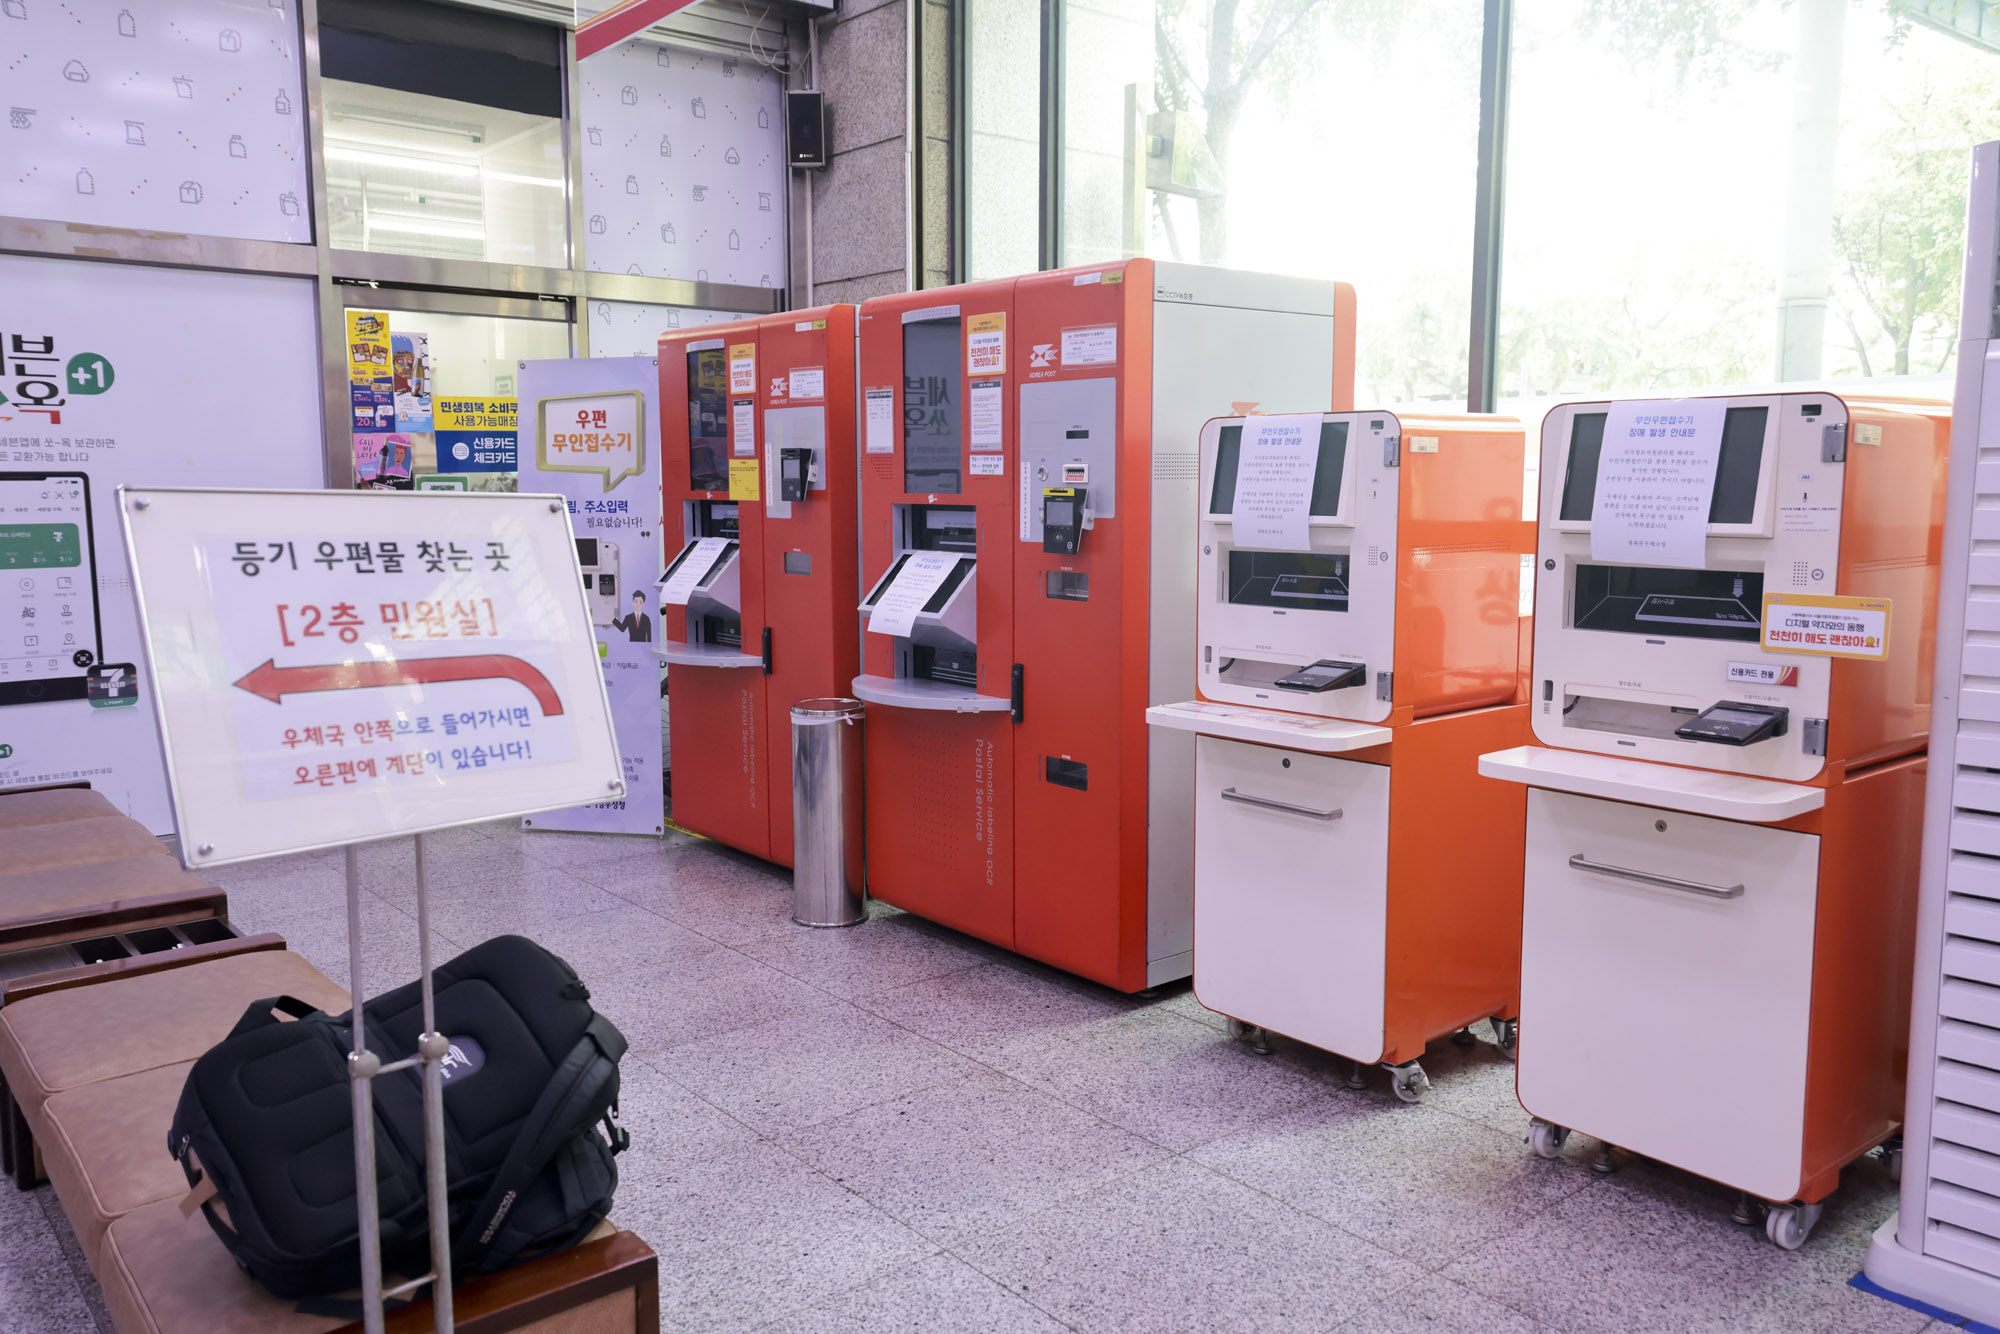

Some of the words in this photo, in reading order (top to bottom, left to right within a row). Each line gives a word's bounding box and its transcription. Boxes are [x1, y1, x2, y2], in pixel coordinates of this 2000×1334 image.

[0, 331, 60, 378] 븐
[71, 361, 105, 388] +1
[1029, 371, 1044, 379] KOREA
[440, 402, 485, 413] 민생회복
[575, 410, 607, 429] 우편
[473, 437, 516, 449] 신용카드
[552, 433, 632, 453] 무인접수기
[473, 452, 516, 464] 체크카드
[584, 499, 628, 514] 주소입력
[586, 517, 643, 529] 필요없습니다!
[232, 541, 298, 577] 등기
[313, 542, 404, 574] 우편물
[417, 540, 472, 572] 찾는
[484, 541, 511, 572] 곳
[277, 602, 365, 647] [2층
[380, 598, 499, 641] 민원실]
[1785, 619, 1810, 629] 디지털
[1812, 620, 1845, 631] 약자와의
[1847, 622, 1865, 632] 동행
[1769, 630, 1802, 643] 천천히
[1805, 633, 1827, 645] 해도
[1829, 634, 1880, 648] 괜찮아요!
[1731, 667, 1758, 678] 신용카드
[1760, 670, 1774, 679] 전용
[281, 721, 345, 749] 우체국
[354, 714, 434, 744] 안쪽으로
[440, 707, 531, 737] 들어가시면
[293, 760, 378, 786] 오른편에
[386, 750, 444, 777] 계단이
[450, 741, 533, 770] 있습니다!
[975, 738, 984, 783] Postal
[986, 741, 994, 803] Automatic
[975, 787, 984, 842] Service
[986, 806, 994, 856] labeling
[986, 859, 994, 886] OCR
